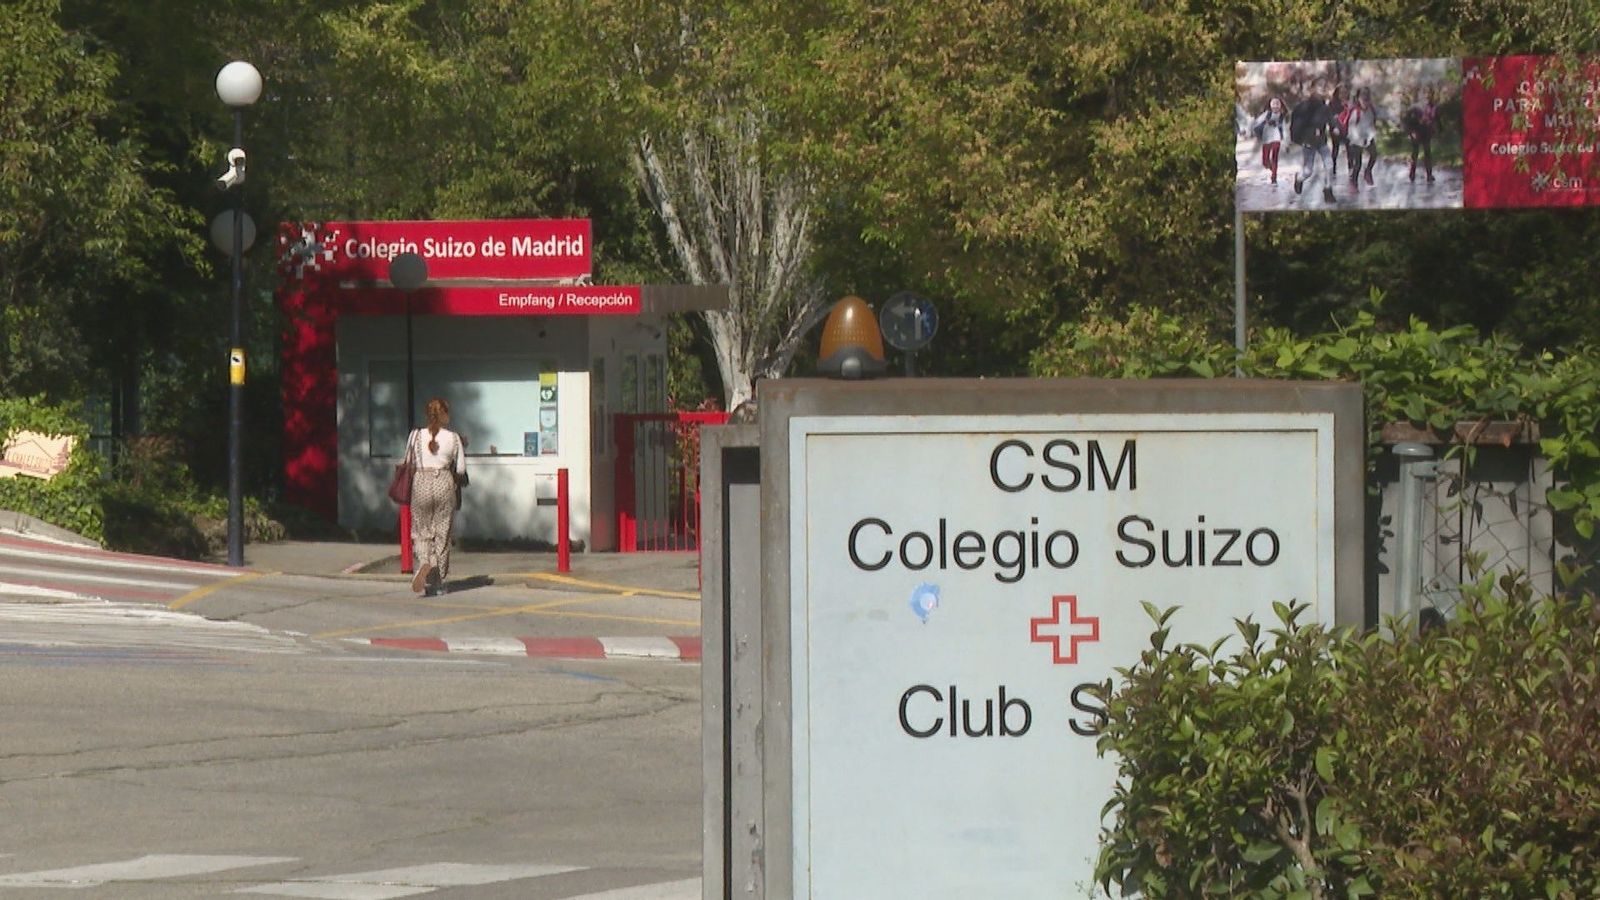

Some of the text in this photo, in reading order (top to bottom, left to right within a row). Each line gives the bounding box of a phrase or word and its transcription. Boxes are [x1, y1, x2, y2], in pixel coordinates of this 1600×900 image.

[1493, 98, 1542, 112] PARA
[1490, 142, 1538, 156] Colegio
[345, 235, 584, 263] Colegio Suizo de Madrid
[499, 293, 555, 308] Empfang
[567, 292, 633, 307] Recepción
[989, 438, 1137, 493] CSM
[847, 514, 1280, 584] Colegio Suizo
[898, 684, 1032, 738] Club
